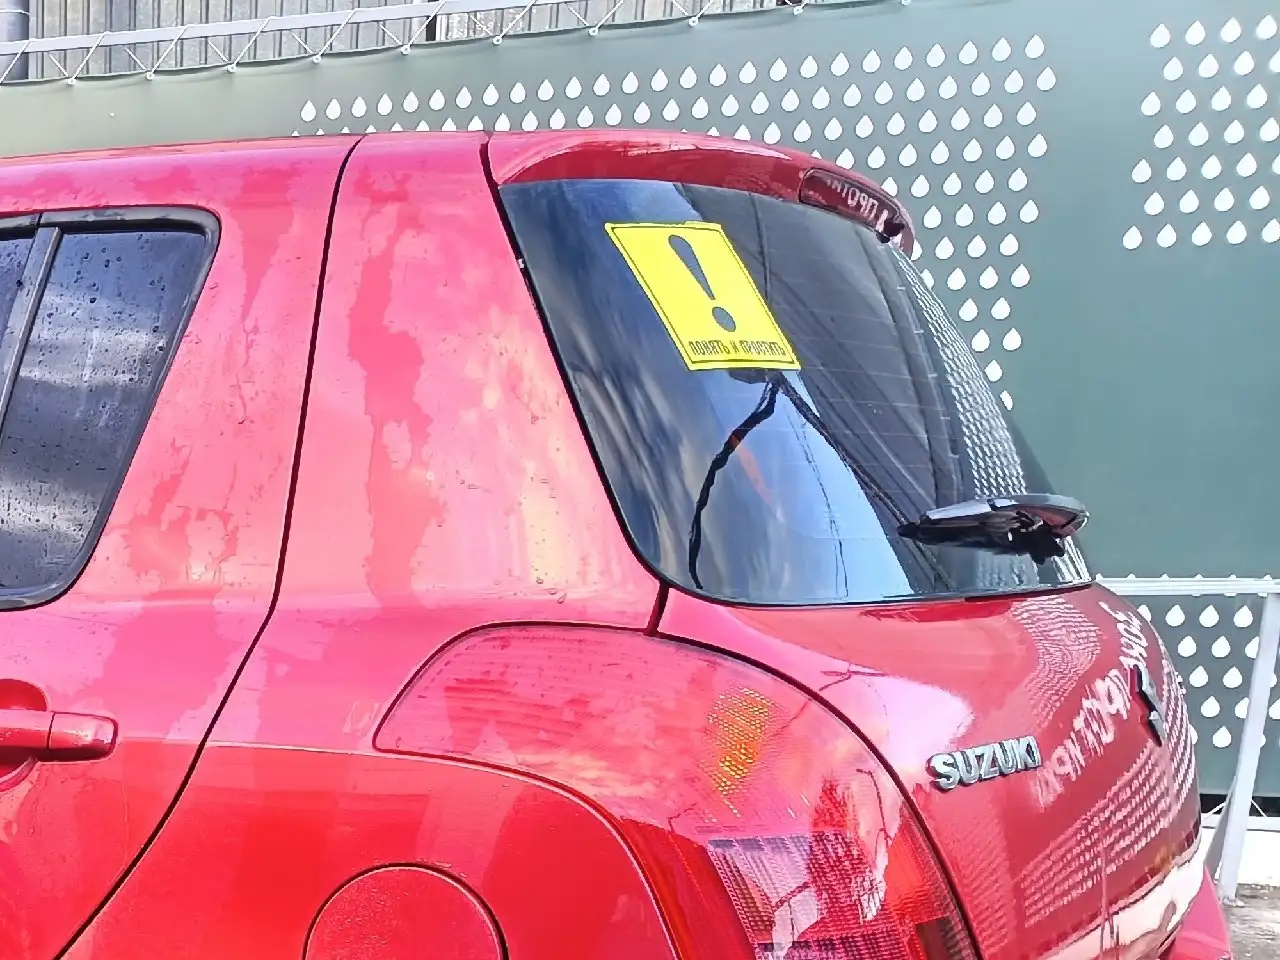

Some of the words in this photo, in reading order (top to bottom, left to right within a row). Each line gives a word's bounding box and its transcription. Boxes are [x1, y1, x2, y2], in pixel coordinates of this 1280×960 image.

[688, 339, 730, 356] ПОНЯТЬ
[729, 339, 740, 354] И
[739, 339, 787, 356] ПРОСТИТЬ
[926, 735, 1042, 792] SUZUKI
